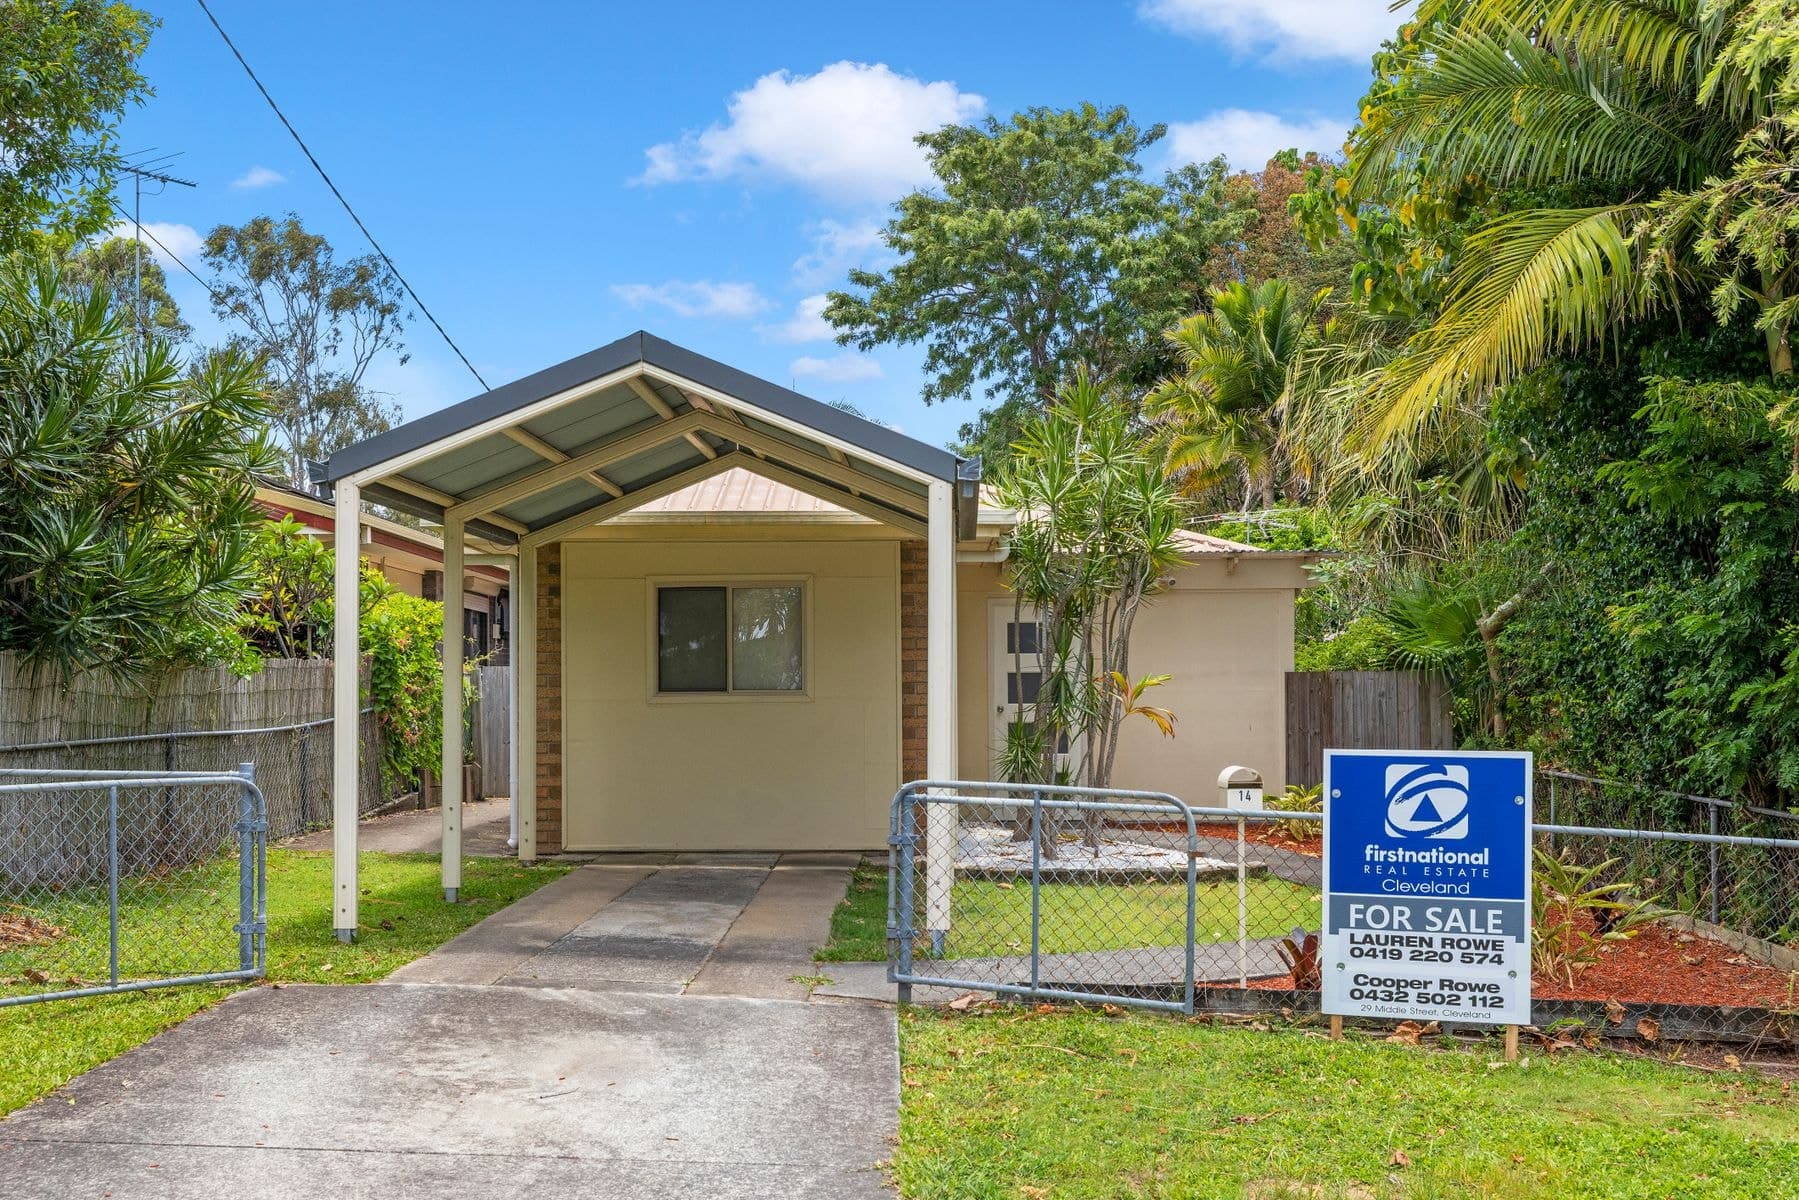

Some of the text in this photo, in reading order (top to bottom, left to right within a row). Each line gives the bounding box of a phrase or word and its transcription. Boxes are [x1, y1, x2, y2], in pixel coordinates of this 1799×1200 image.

[1239, 790, 1251, 801] 14
[1365, 844, 1489, 865] firstnational
[1364, 865, 1489, 878] REAL ESTATE
[1382, 878, 1470, 895] Cleveland
[1350, 904, 1503, 934] FOR SALE
[1350, 933, 1504, 951] LAUREN ROWE
[1350, 946, 1504, 965] 0419 220 574
[1354, 973, 1500, 993] Cooper Rowe
[1350, 988, 1504, 1008] 0432 502 112
[1361, 1004, 1491, 1019] 29 Middle Street, Cleveland
